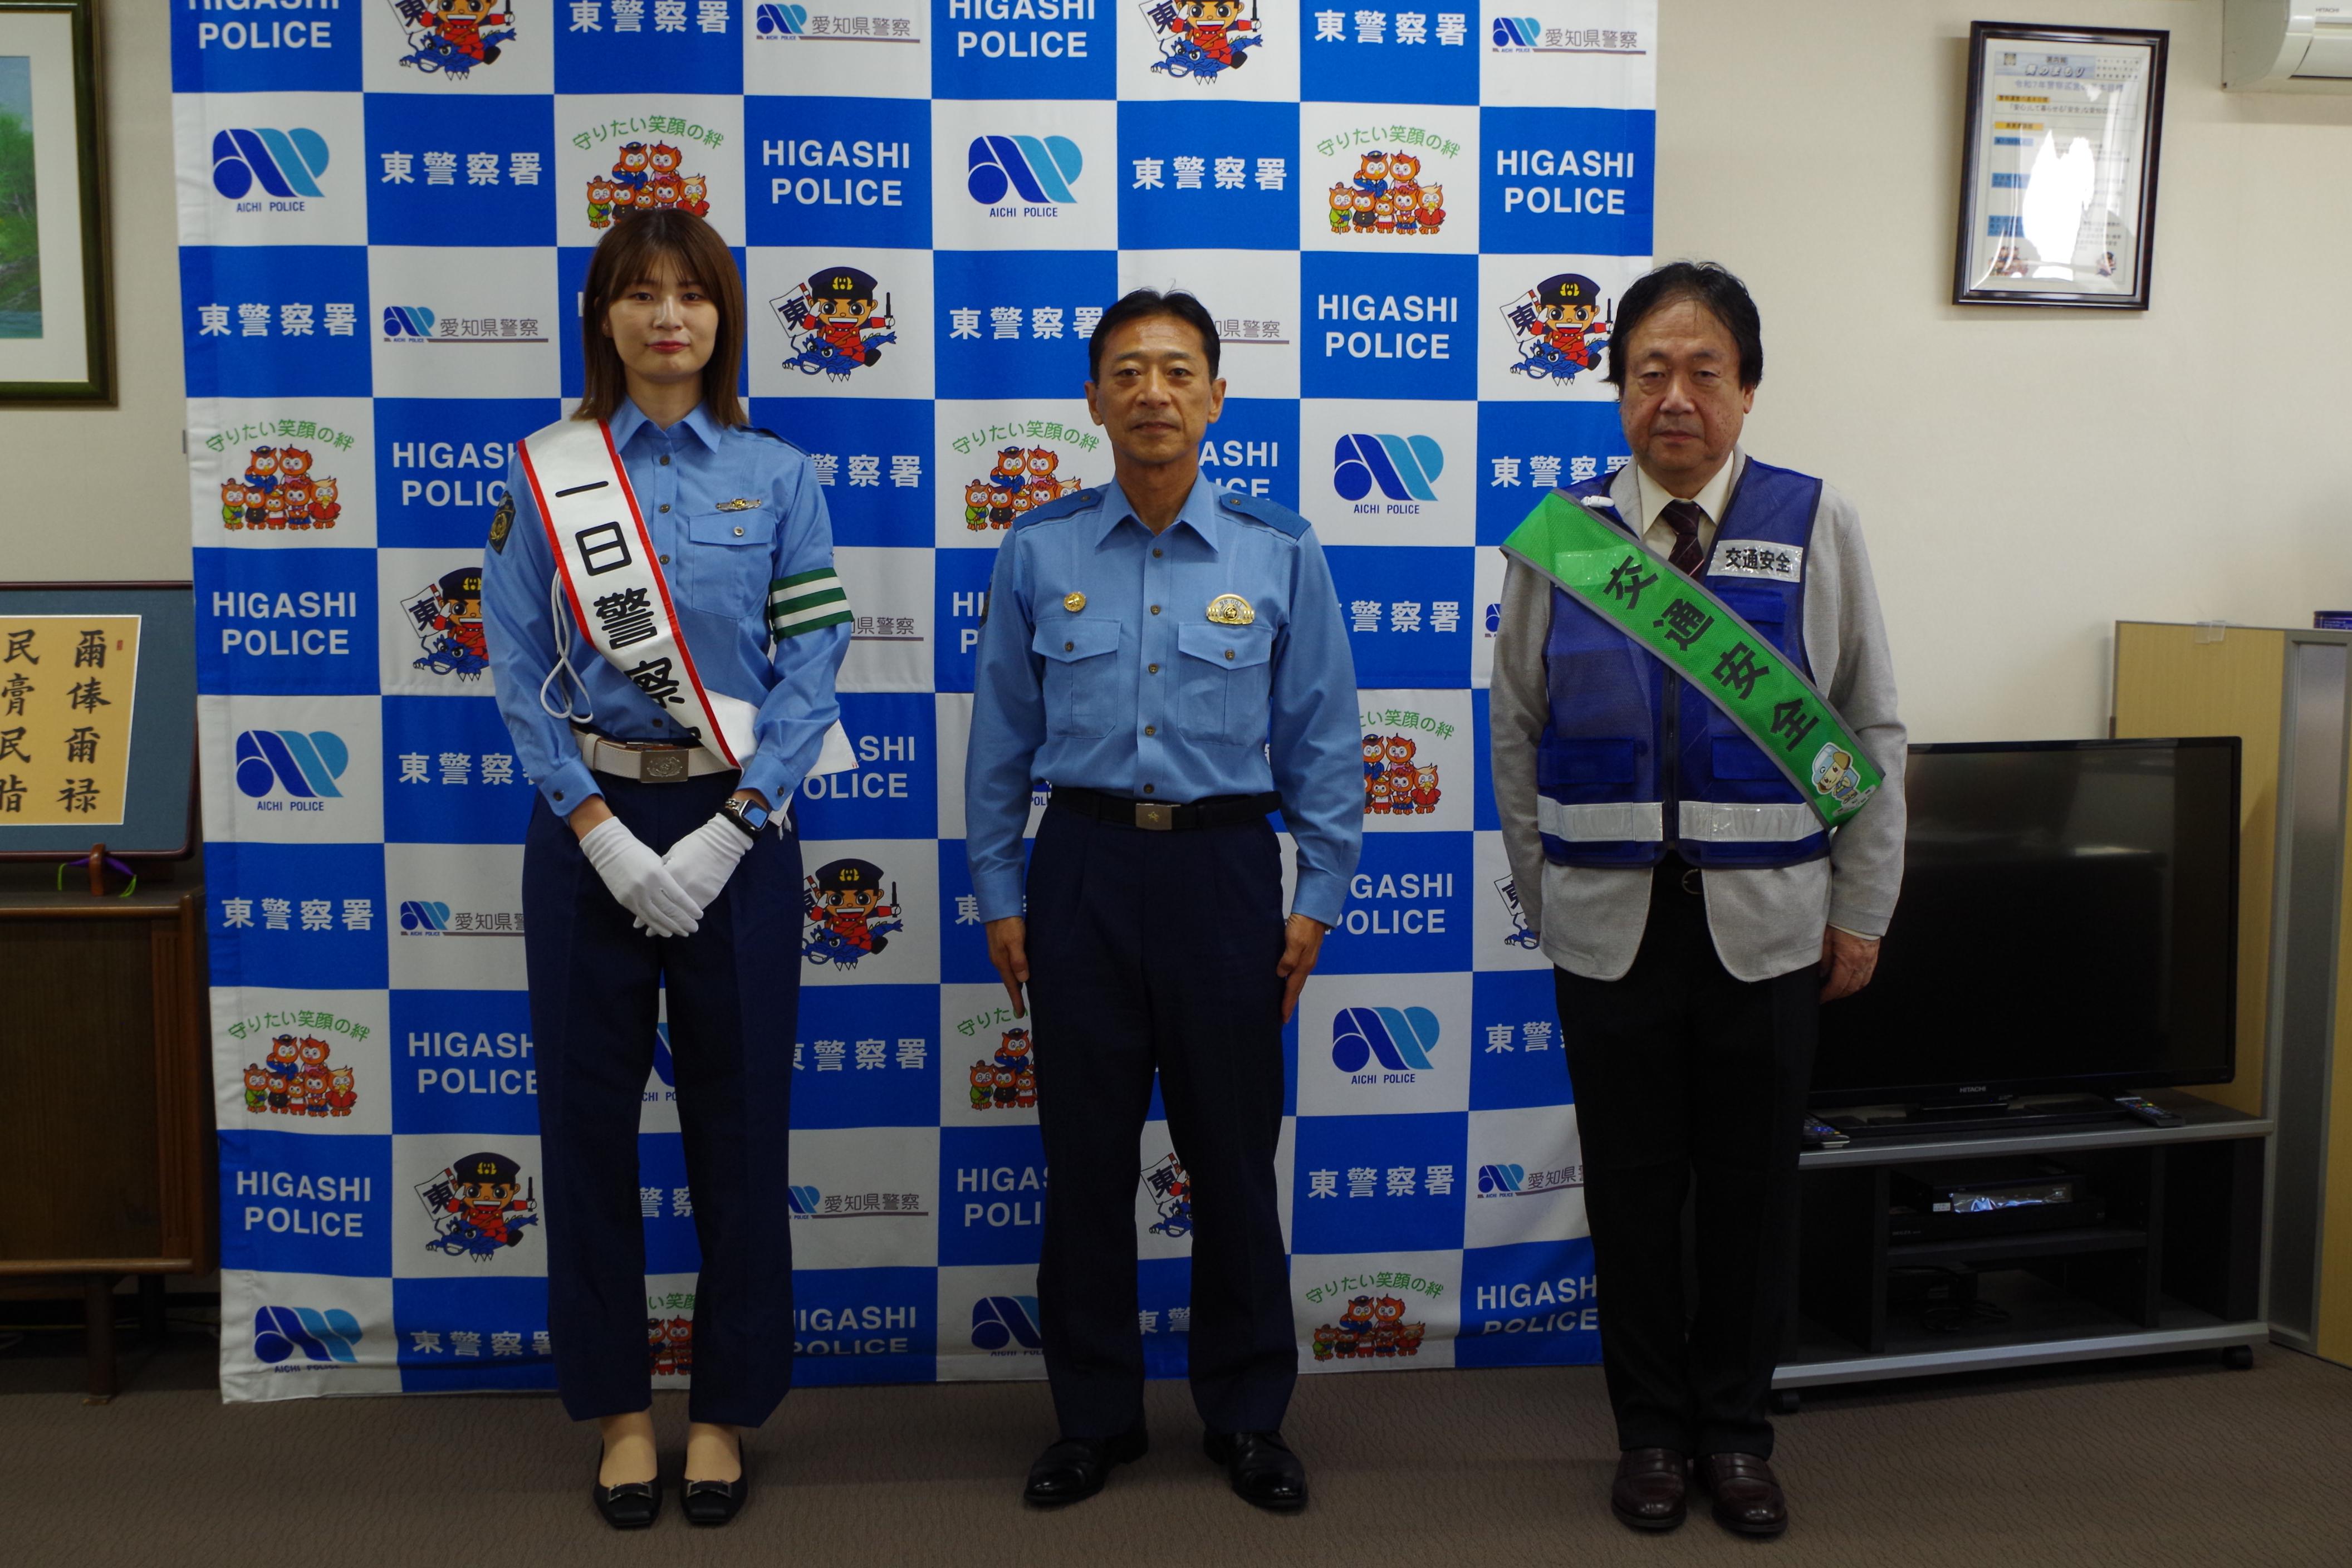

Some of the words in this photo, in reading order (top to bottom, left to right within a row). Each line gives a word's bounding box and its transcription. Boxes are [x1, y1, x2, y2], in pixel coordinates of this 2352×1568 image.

[569, 0, 730, 33] 東警察署
[949, 0, 1095, 20] HIGASHI
[199, 21, 332, 50] POLICE
[811, 16, 912, 37] 愛知県警察
[1314, 9, 1467, 46] 東警察署
[1544, 28, 1638, 48] 愛知県警察
[958, 31, 1087, 58] POLICE
[572, 115, 724, 150] 守りたい笑顔の絆
[1317, 125, 1461, 158] 守りたい笑顔の絆
[380, 150, 542, 186] 東警察署
[763, 140, 909, 169] HIGASHI
[1497, 149, 1634, 178] HIGASHI
[1132, 156, 1287, 190] 東警察署
[772, 178, 903, 206] POLICE
[1505, 187, 1625, 215] POLICE
[236, 202, 262, 213] AICHI
[269, 201, 305, 212] POLICE
[989, 207, 1016, 217] AICHI
[1023, 207, 1057, 217] POLICE
[198, 302, 357, 337] 東警察署
[1318, 294, 1457, 322] HIGASHI
[440, 318, 538, 337] 愛知県警察
[949, 306, 1104, 340] 東警察署
[1217, 317, 1281, 339] 県警察
[1326, 331, 1449, 359] POLICE
[204, 419, 356, 453] 守りたい笑顔の絆
[953, 420, 1100, 455] 守りたい笑顔の絆
[393, 442, 517, 469] HIGAS
[1198, 440, 1278, 467] ASHI
[806, 454, 922, 488] 警察署
[402, 480, 507, 507] POLIC
[1354, 504, 1380, 514] AICHI
[1386, 504, 1420, 514] POLICE
[1724, 547, 1791, 574] 交通安全
[213, 591, 356, 619] HIGASHI
[555, 480, 702, 741] 一日警察
[1350, 600, 1461, 633] 警察署
[851, 616, 915, 635] 県警察
[222, 629, 349, 656] POLICE
[1603, 555, 1820, 753] 交通安全
[1359, 708, 1455, 741] い笑顔の絆
[399, 752, 536, 785] 東警察
[802, 772, 908, 800] OLICE
[257, 801, 283, 811] AICHI
[290, 801, 324, 811] POLICE
[1350, 873, 1453, 899] GASHI
[222, 897, 374, 932] 東警察署
[454, 912, 525, 931] 愛知県警
[1325, 909, 1447, 935] OLICE
[227, 1009, 370, 1041] 守りたい笑顔の絆
[1484, 1020, 1566, 1055] 東警
[408, 1032, 535, 1058] HIGASH
[418, 1067, 537, 1095] POLICE
[1351, 1075, 1377, 1085] AICHI
[1383, 1074, 1415, 1084] POLICE
[237, 1171, 370, 1202] HIGASHI
[956, 1166, 1049, 1193] HIGA
[1307, 1165, 1454, 1199] 東警察署
[1527, 1165, 1584, 1190] 愛知県
[640, 1186, 694, 1218] 警察
[824, 1193, 920, 1213] 愛知県警察
[964, 1200, 1041, 1227] POLI
[245, 1207, 363, 1237] POLICE
[1305, 1272, 1443, 1304] 守りたい笑顔の絆
[1477, 1274, 1597, 1310] HIGASH
[793, 1305, 917, 1332] IGASHI
[1139, 1306, 1190, 1335] 東警
[1481, 1307, 1598, 1335] POLICE
[410, 1330, 551, 1357] 東警察署
[273, 1365, 302, 1373] AICHI
